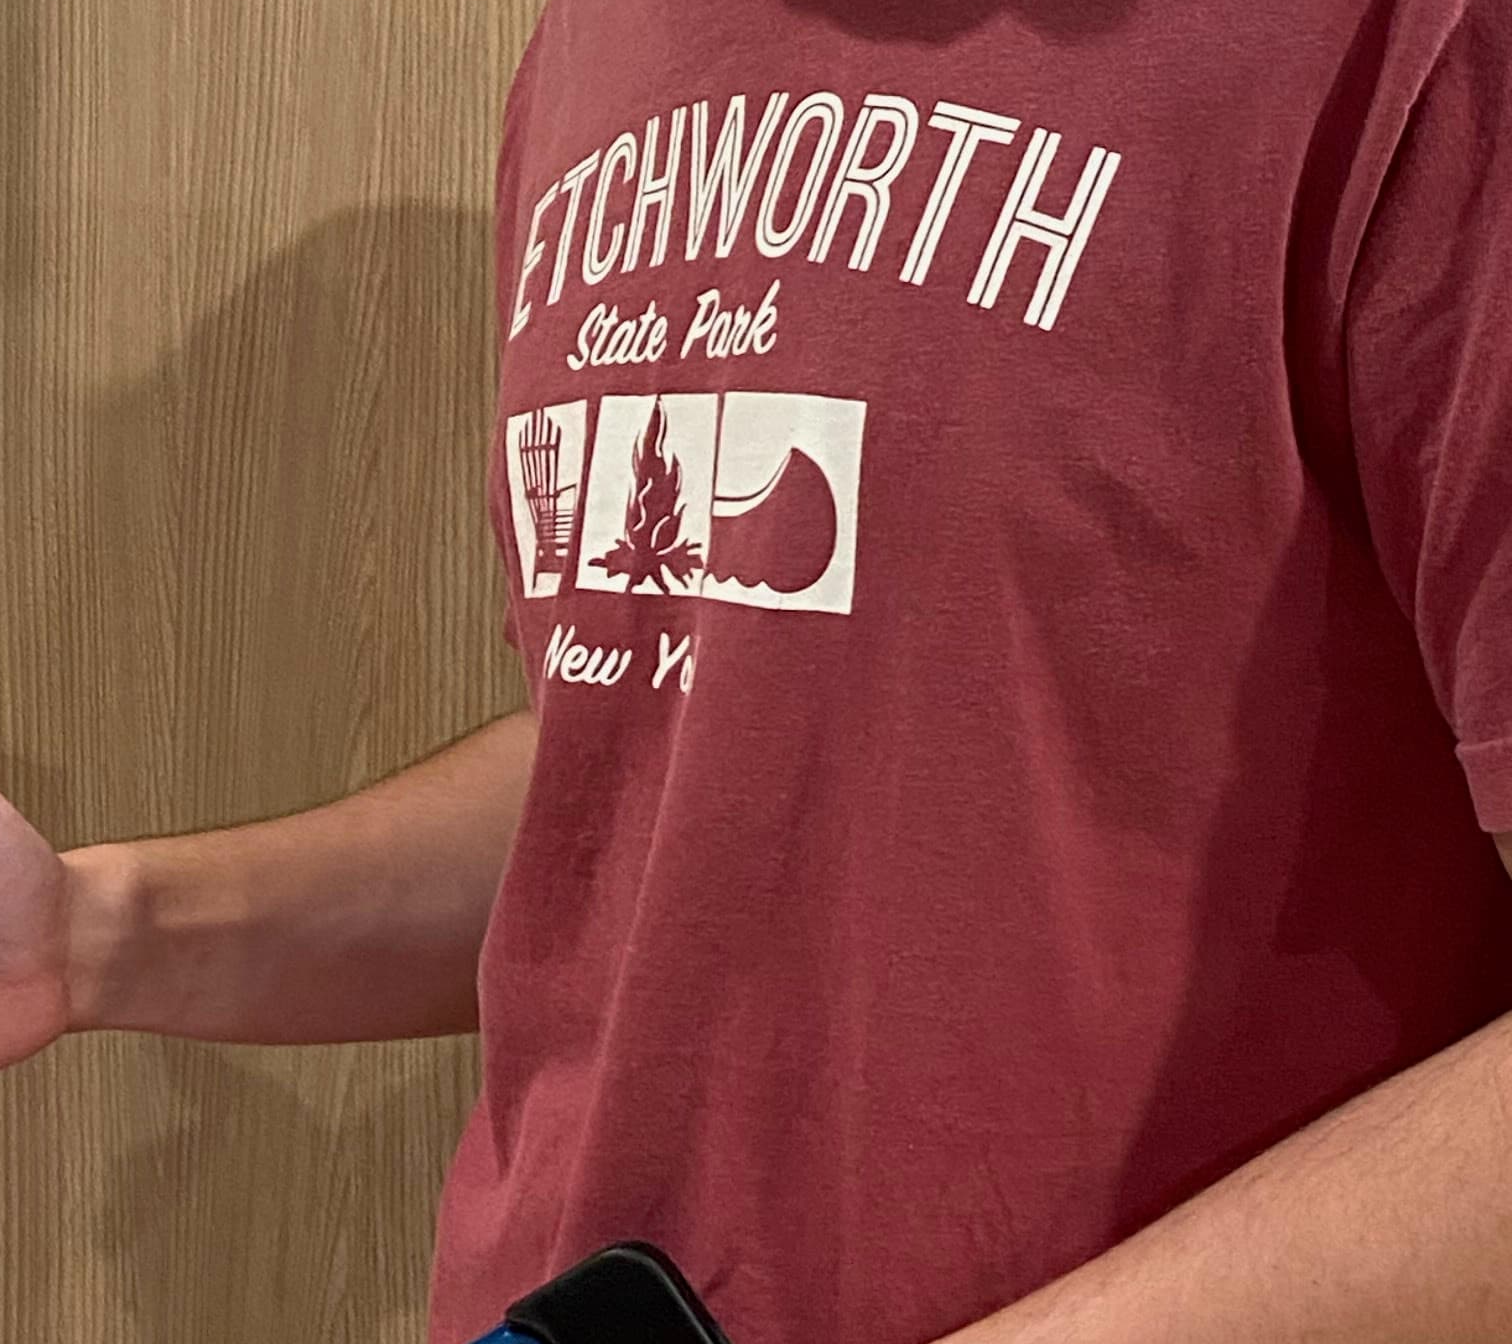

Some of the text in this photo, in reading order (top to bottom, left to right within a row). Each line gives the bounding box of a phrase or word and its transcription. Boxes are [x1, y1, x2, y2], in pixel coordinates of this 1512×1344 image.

[508, 92, 1122, 341] ETCHWORTH
[567, 279, 781, 371] State Park
[543, 623, 694, 696] New Yo
